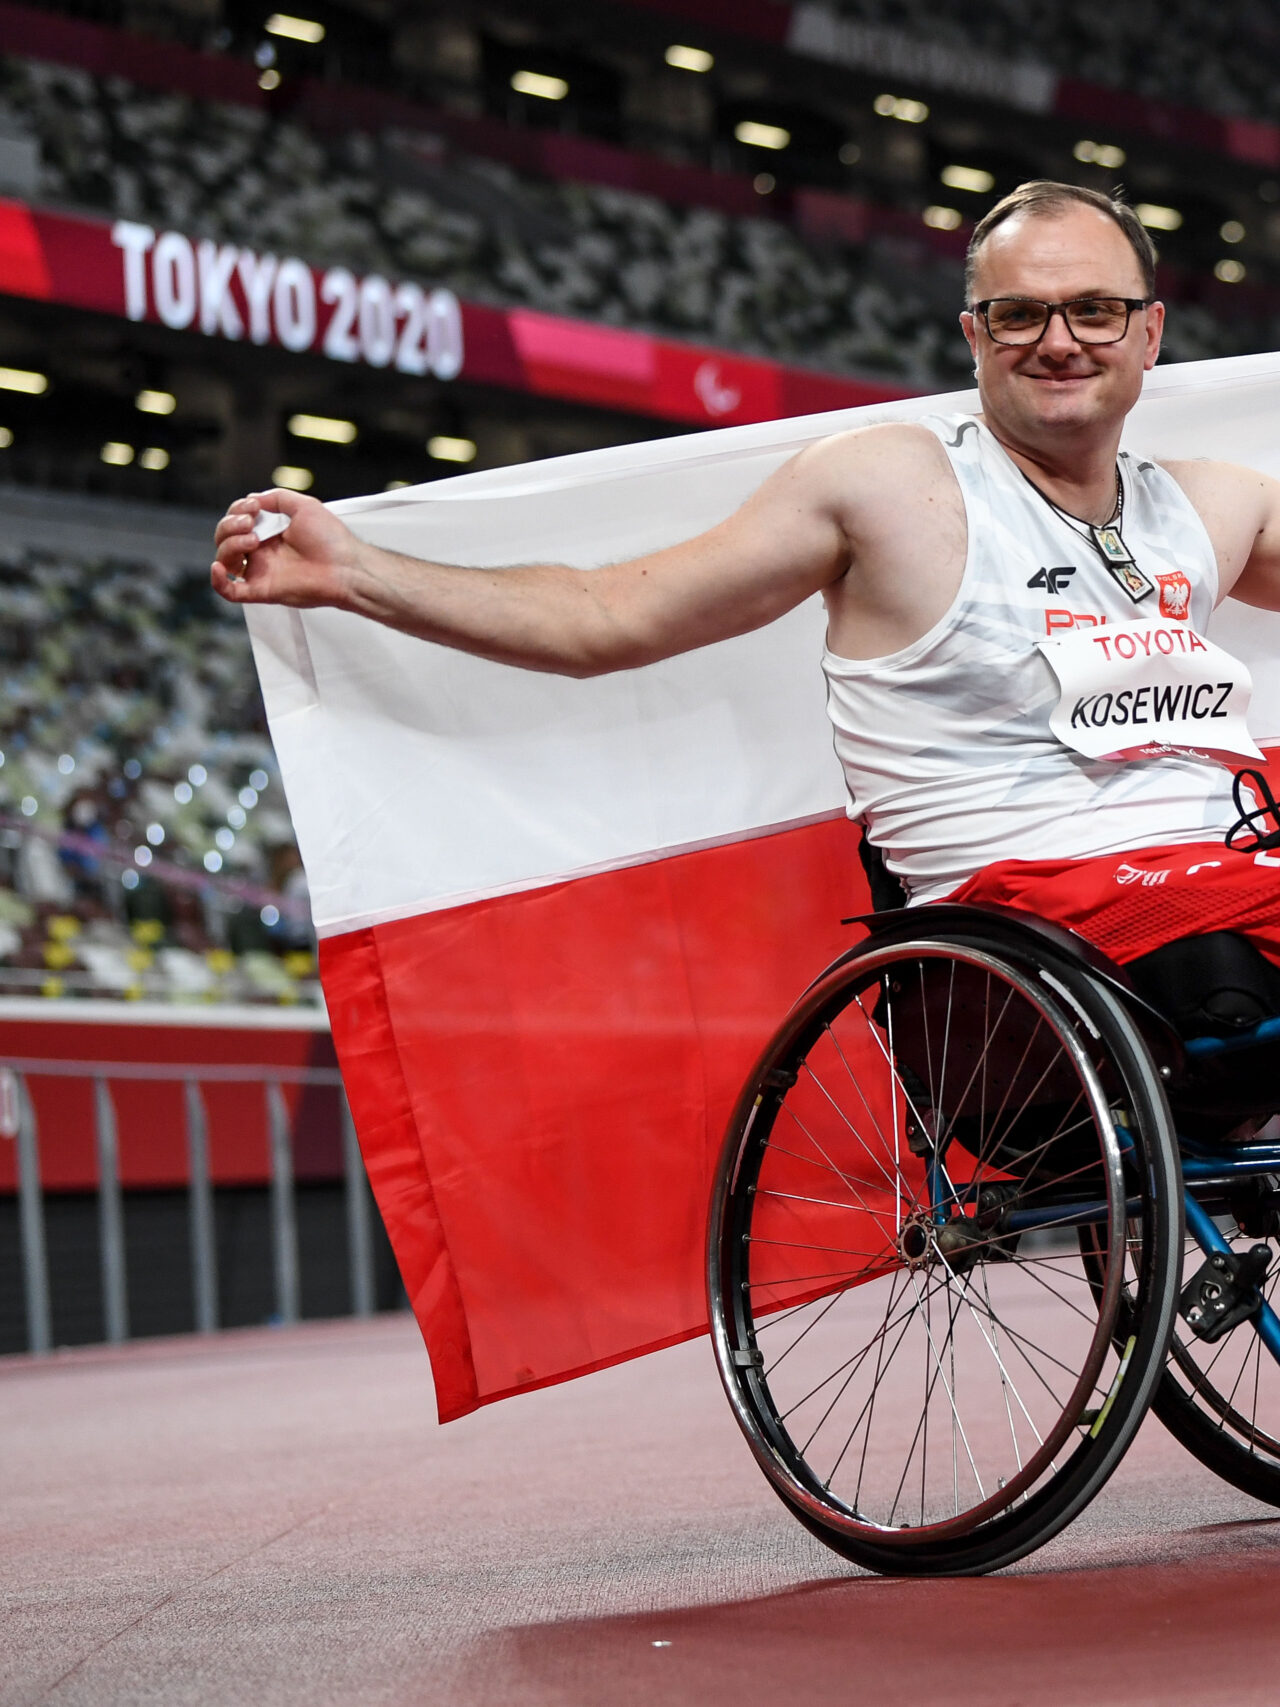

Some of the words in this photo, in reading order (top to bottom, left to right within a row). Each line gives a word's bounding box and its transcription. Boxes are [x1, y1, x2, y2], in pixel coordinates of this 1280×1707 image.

[112, 220, 317, 352] TOKYO
[321, 266, 464, 381] 2020
[1027, 567, 1077, 595] 4F
[1093, 629, 1208, 661] TOYOTA
[1071, 682, 1234, 729] KOSEWICZ
